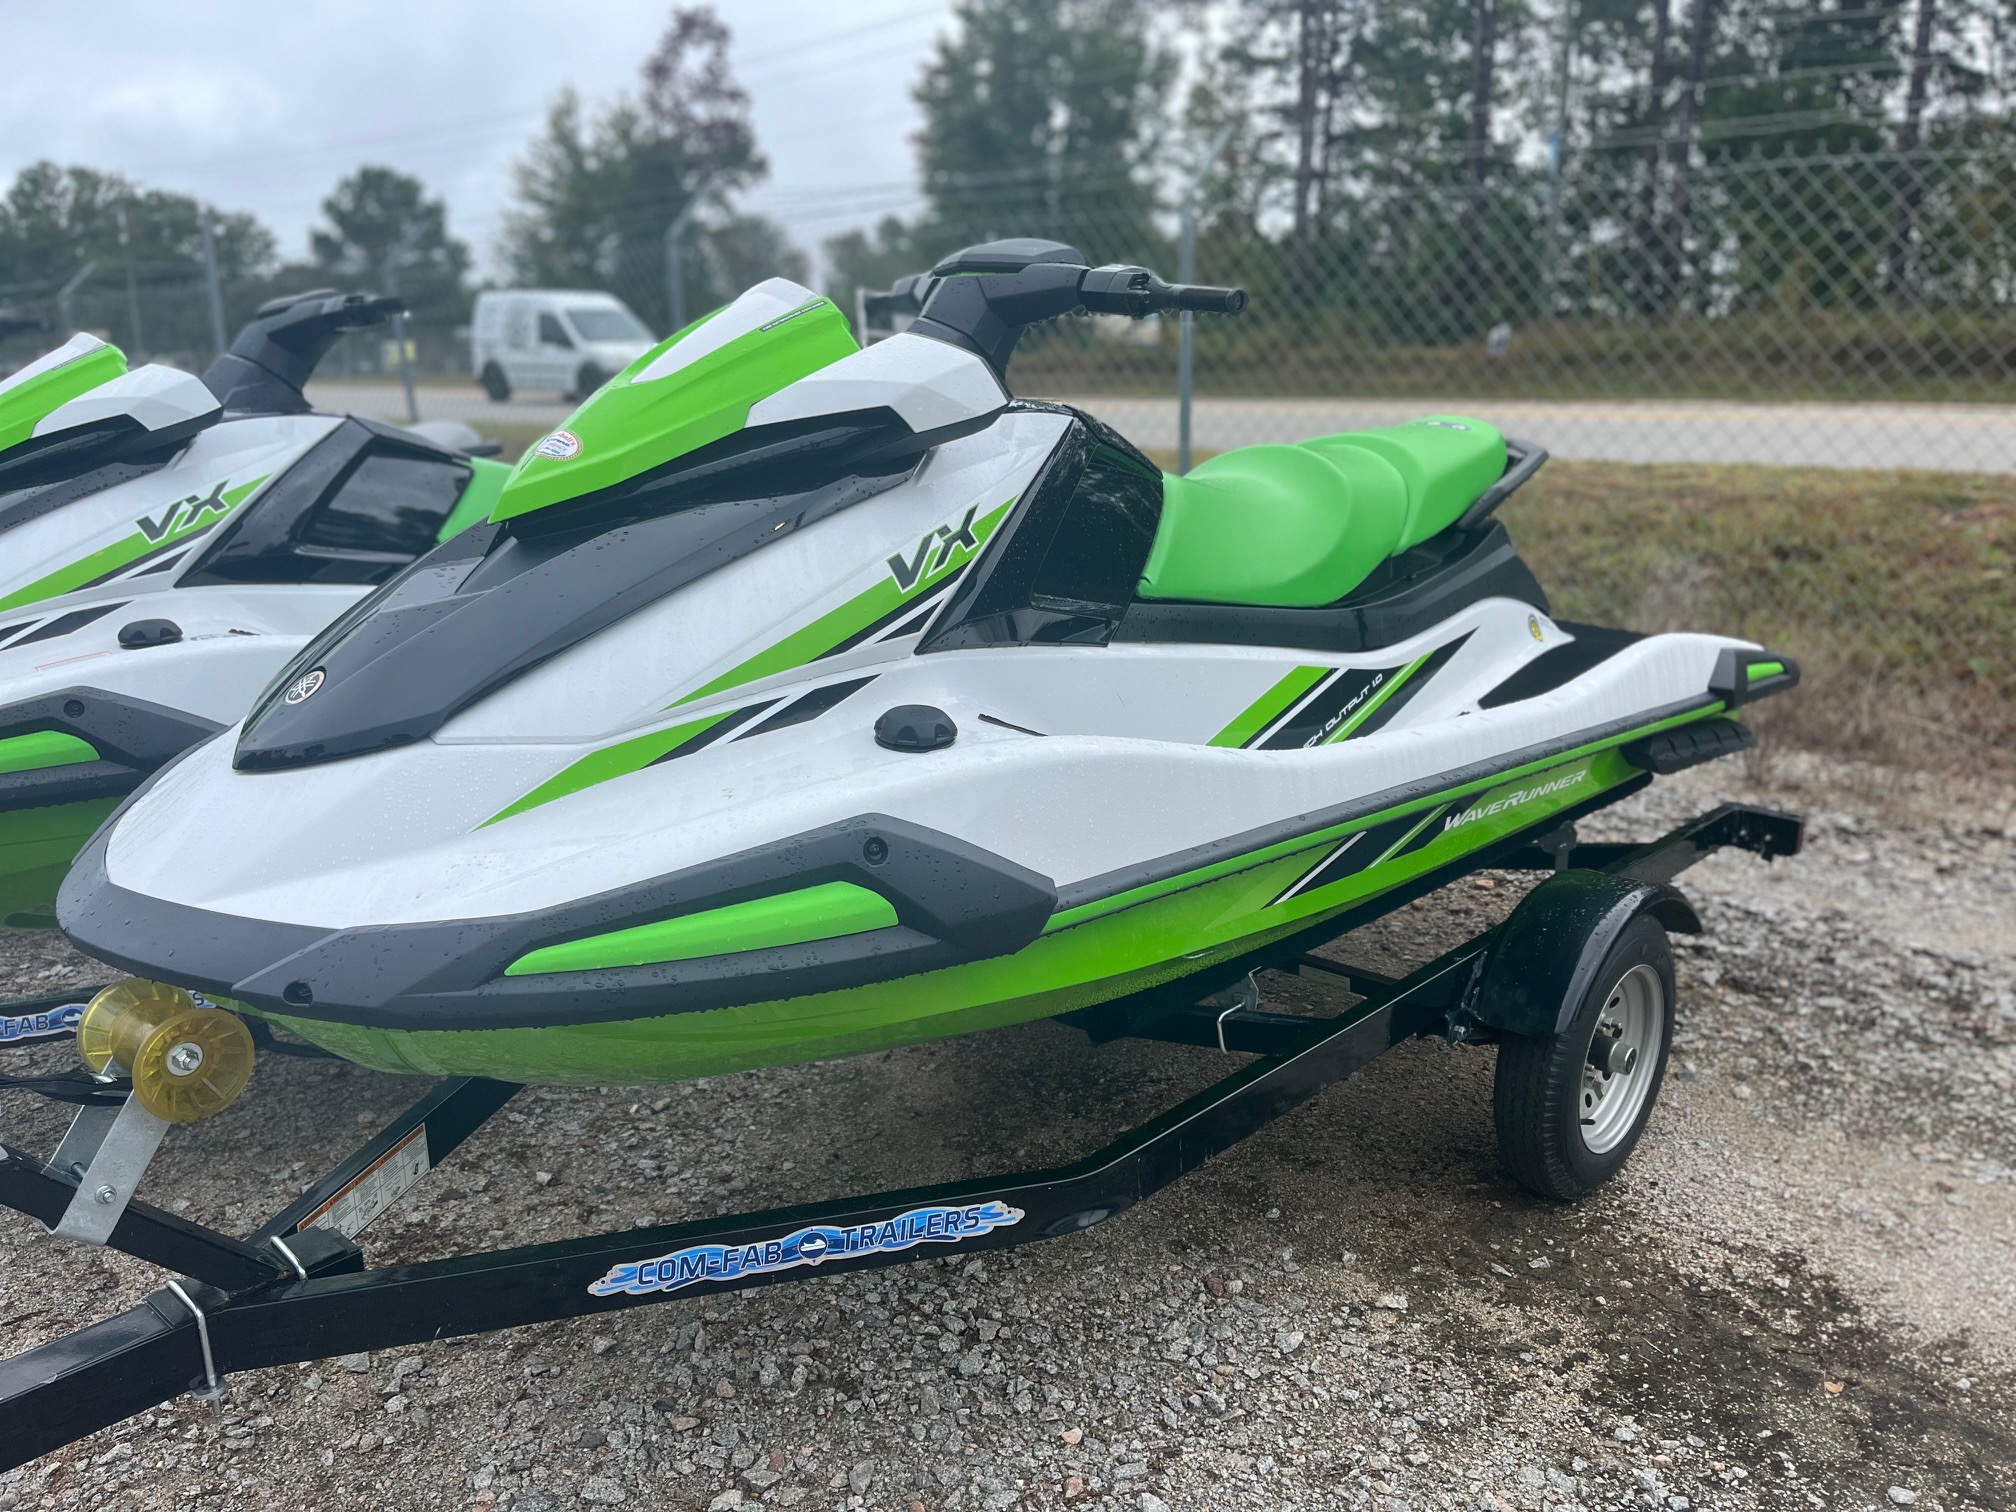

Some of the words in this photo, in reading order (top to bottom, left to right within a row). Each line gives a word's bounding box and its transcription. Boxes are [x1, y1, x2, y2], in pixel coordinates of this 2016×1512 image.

[135, 479, 231, 544] VX
[886, 502, 980, 594] VX
[1325, 684, 1370, 731] OUTPUT
[637, 1241, 783, 1285] COM-FAB
[840, 1207, 981, 1252] TRAILERS
